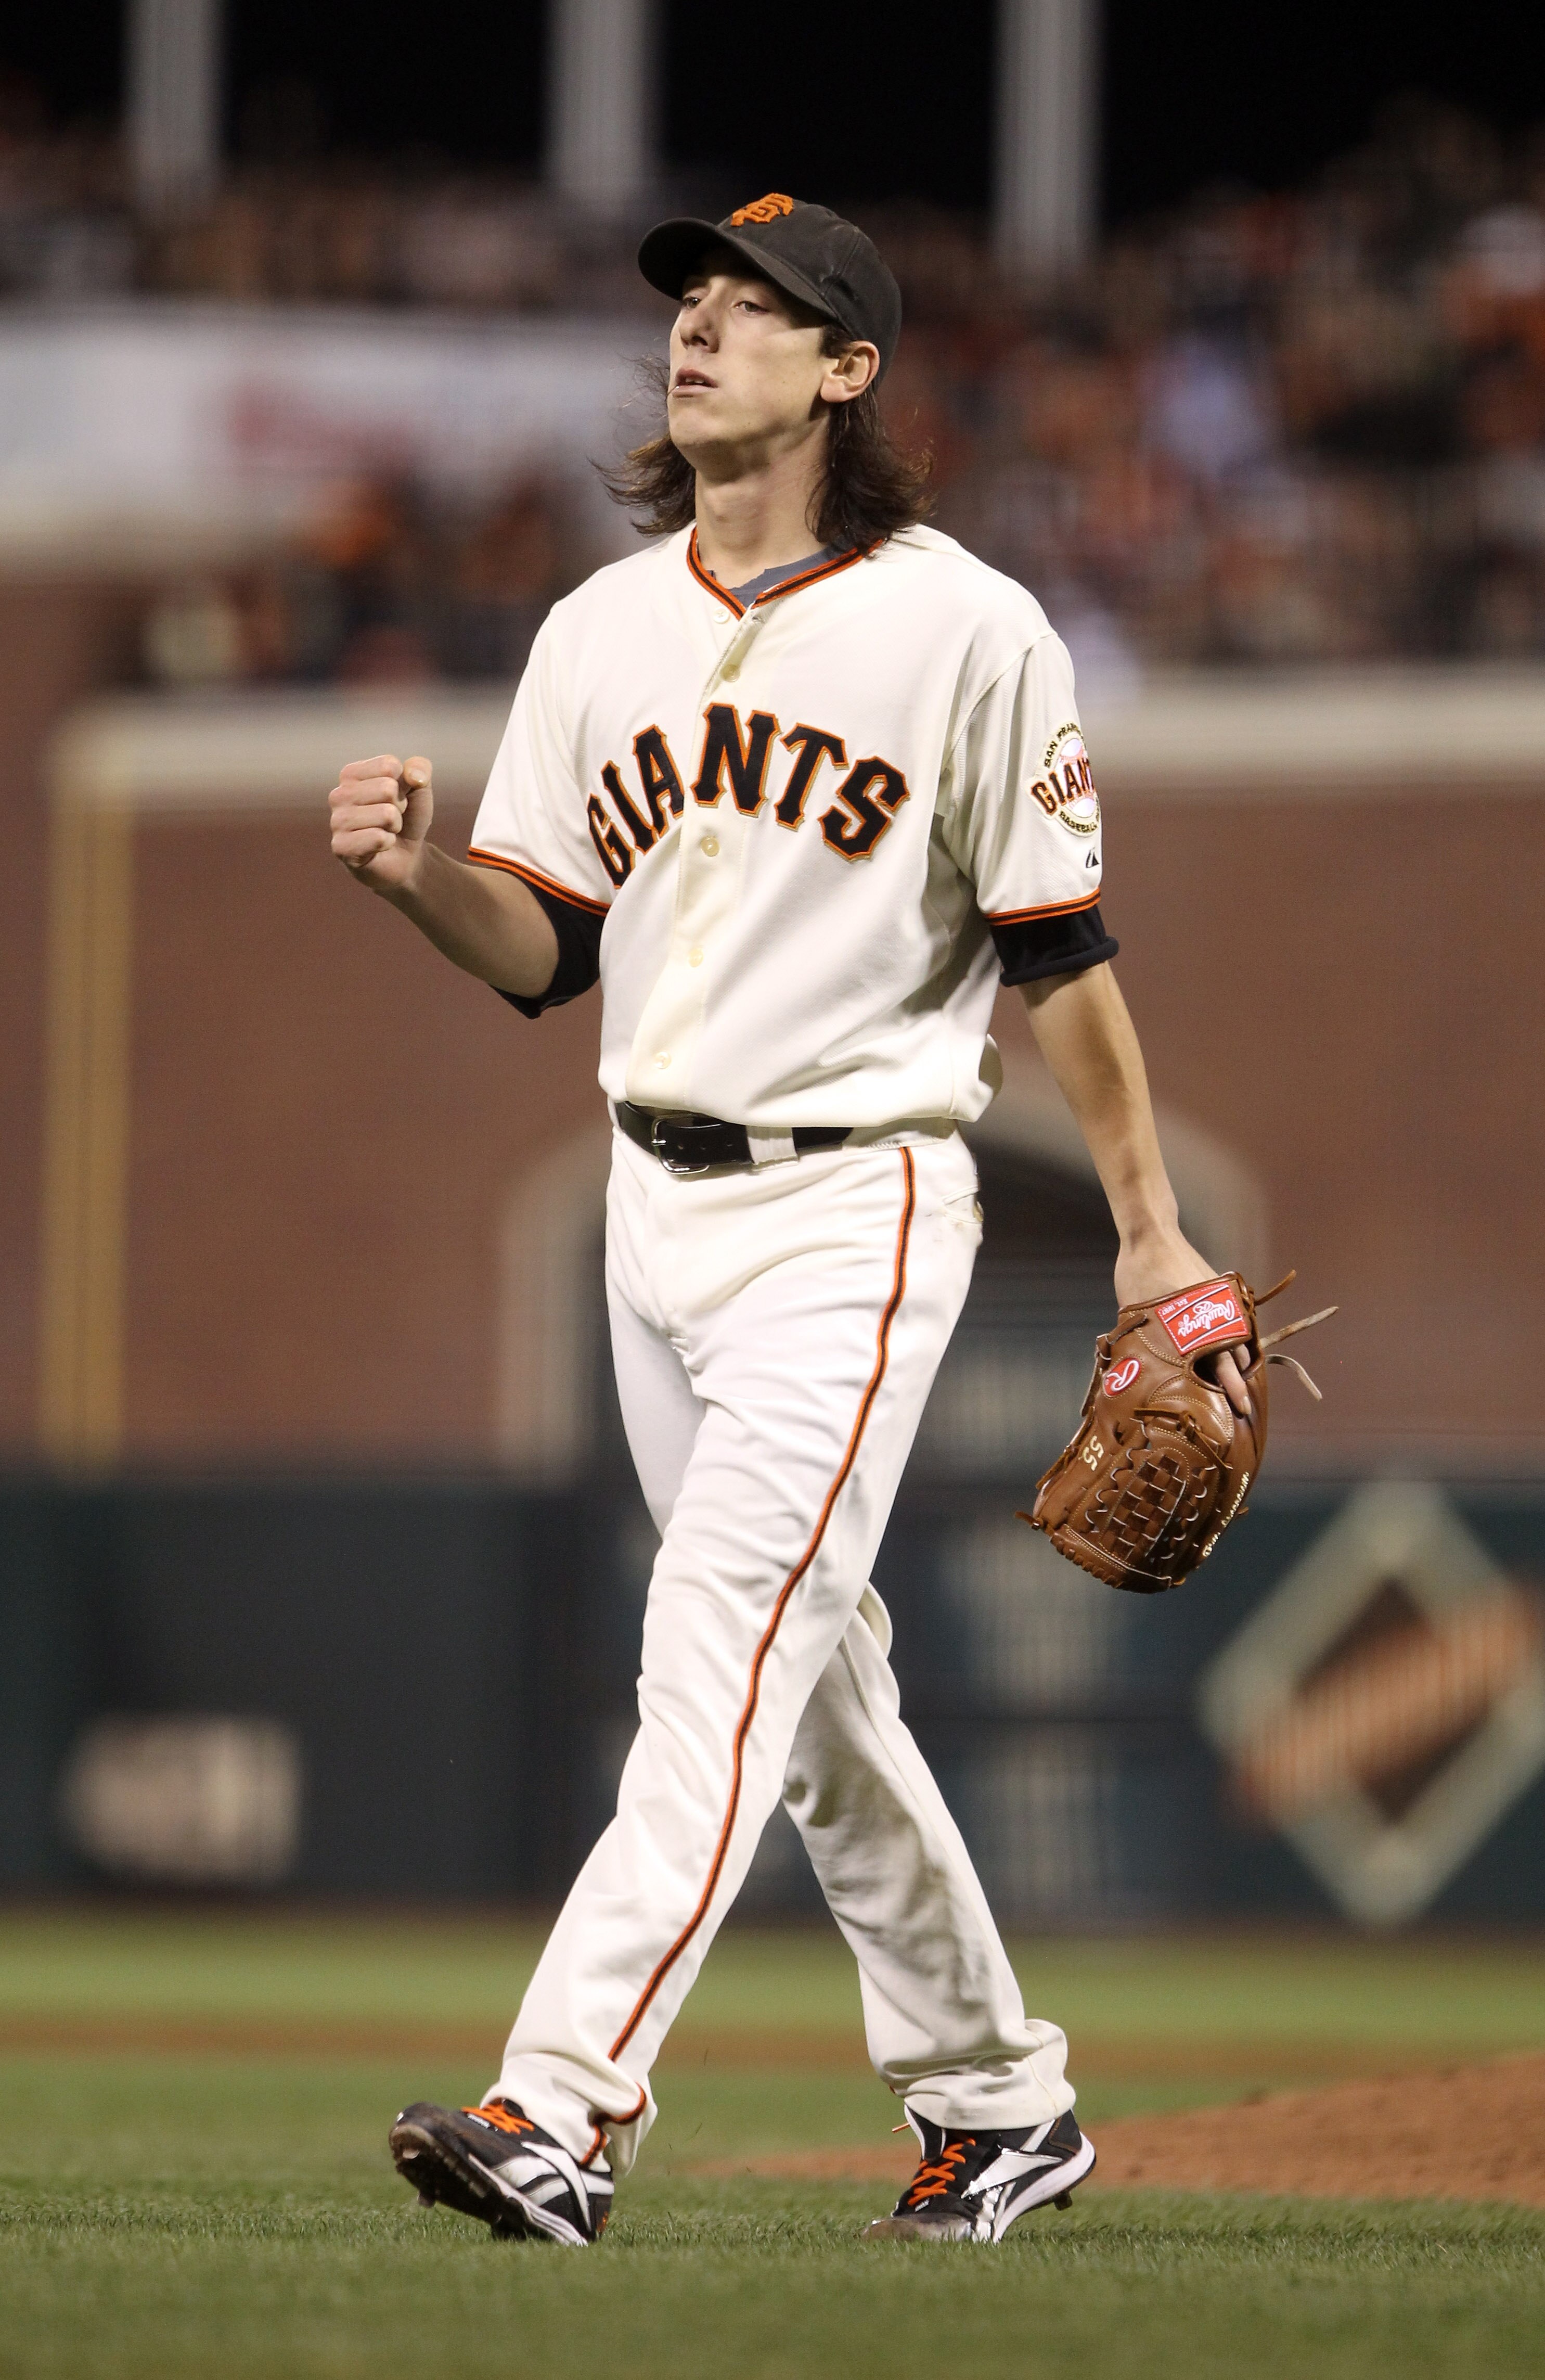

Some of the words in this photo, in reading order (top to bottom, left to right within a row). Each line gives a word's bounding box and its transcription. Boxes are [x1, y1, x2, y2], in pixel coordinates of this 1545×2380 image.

[587, 702, 910, 889] GIANTS
[1177, 1300, 1234, 1337] Rawlings
[1082, 1435, 1104, 1471] 55
